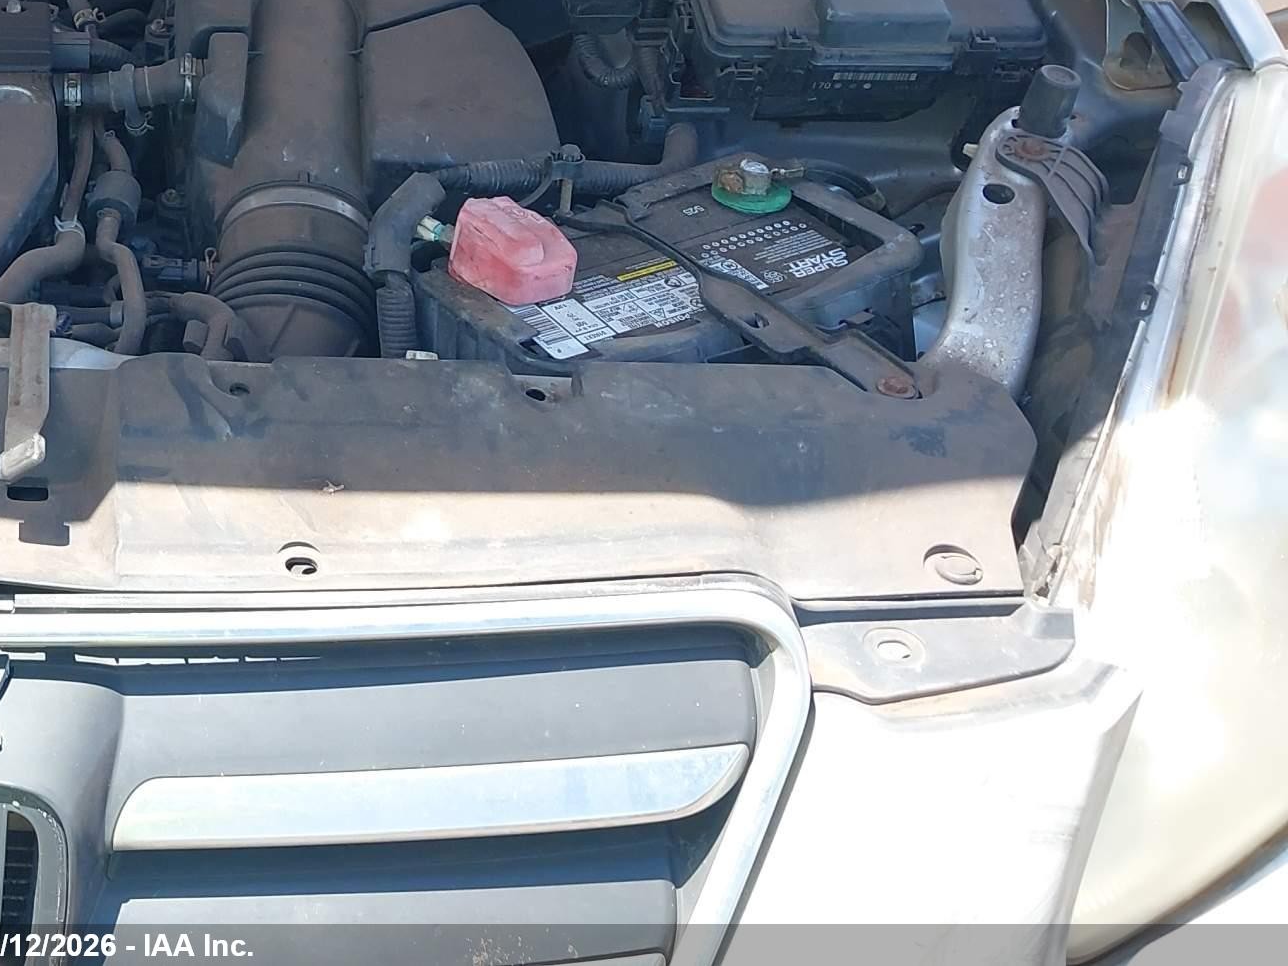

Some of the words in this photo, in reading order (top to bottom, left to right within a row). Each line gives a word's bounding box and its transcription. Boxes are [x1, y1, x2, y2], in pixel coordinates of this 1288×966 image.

[786, 247, 847, 272] START
[792, 257, 849, 278] SUPER
[654, 313, 691, 329] POISON
